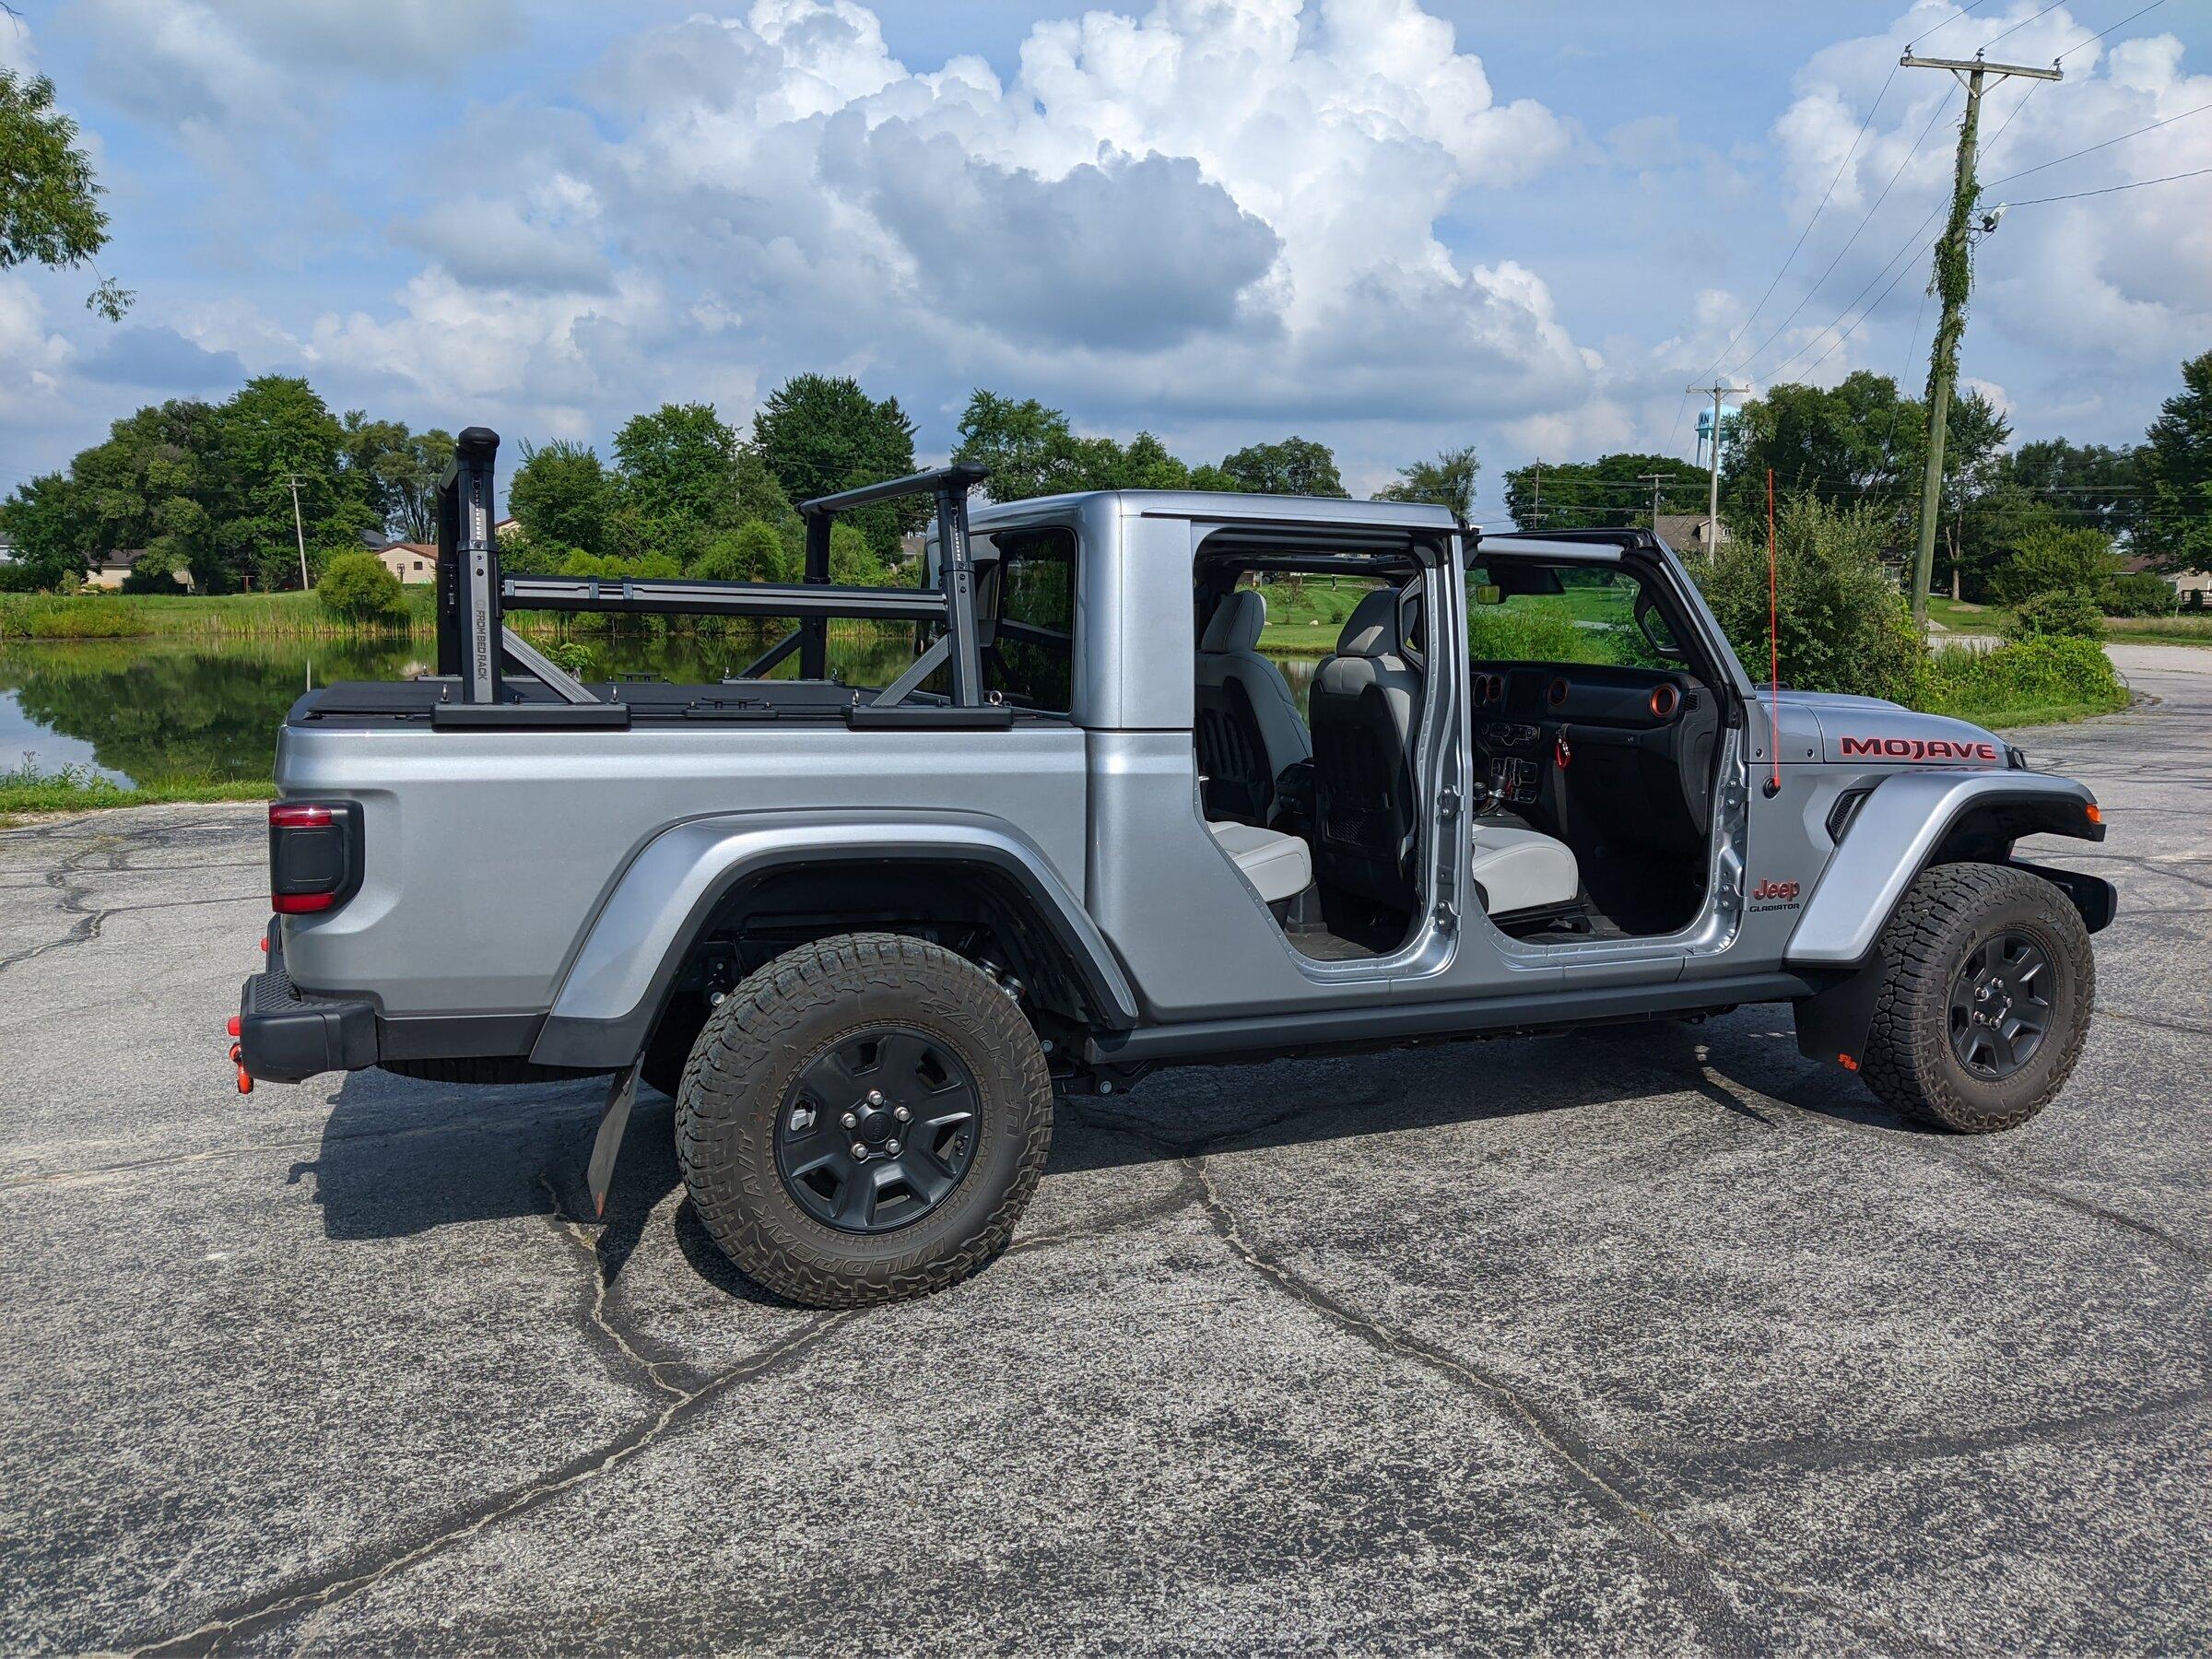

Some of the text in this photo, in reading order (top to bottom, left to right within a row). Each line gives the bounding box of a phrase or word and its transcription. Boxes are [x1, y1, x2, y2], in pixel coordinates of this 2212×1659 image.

[1840, 736, 1998, 760] MOJAVE
[1753, 877, 1801, 902] Jeep
[1749, 903, 1800, 912] GLADIATOR
[750, 1204, 946, 1277] WILDPEAK
